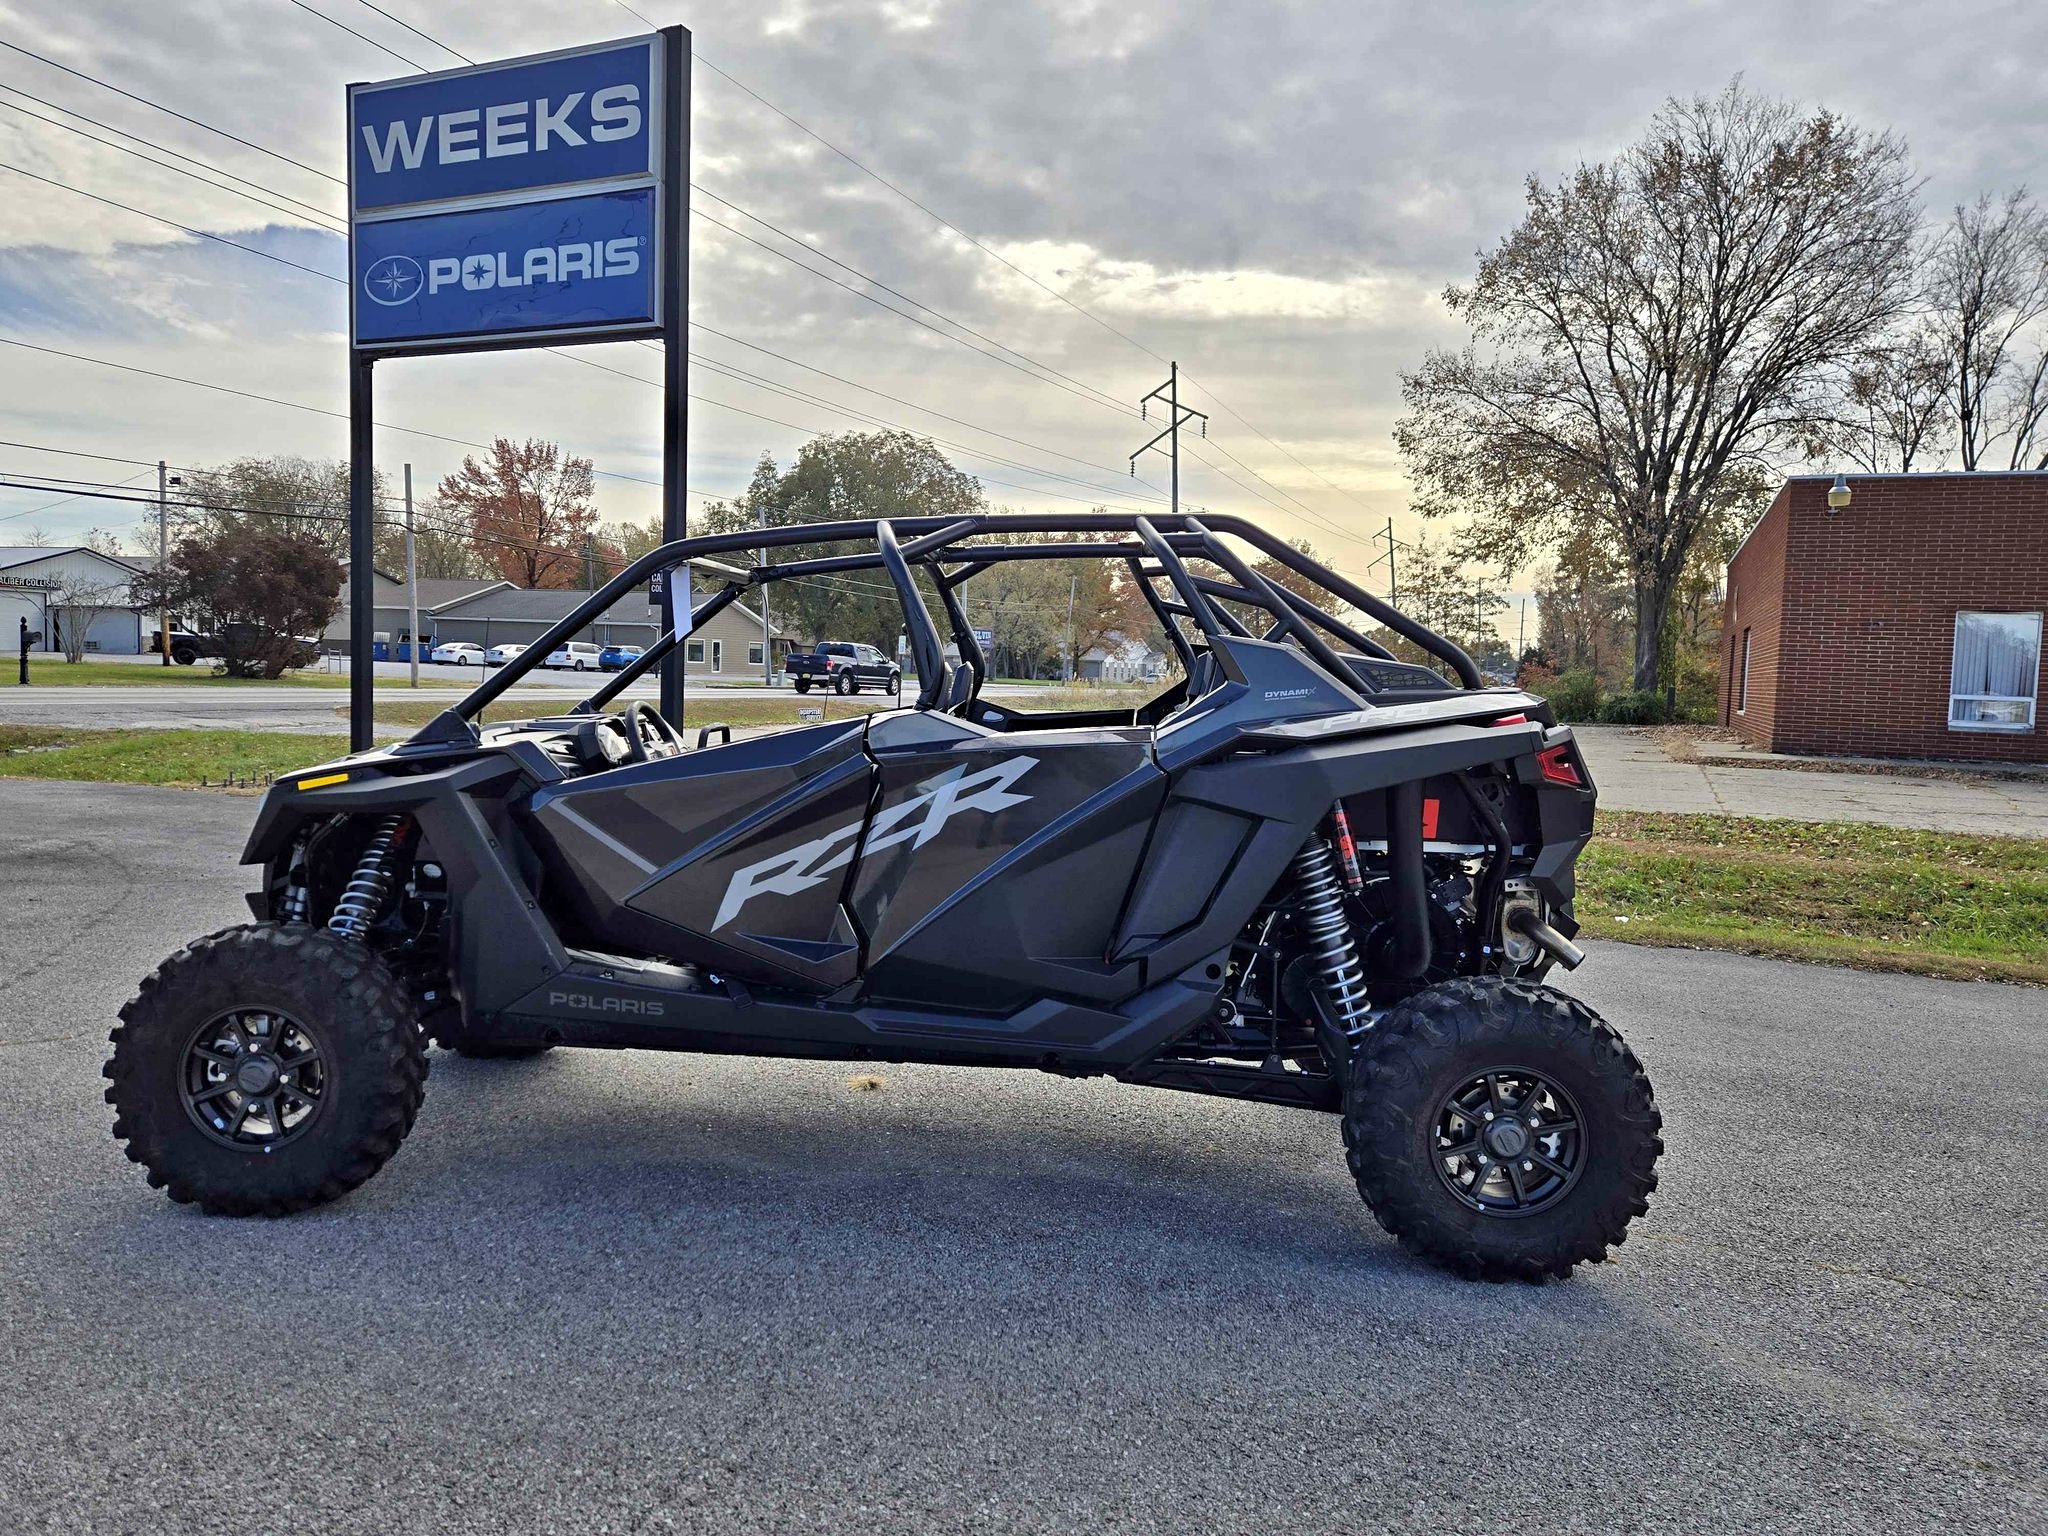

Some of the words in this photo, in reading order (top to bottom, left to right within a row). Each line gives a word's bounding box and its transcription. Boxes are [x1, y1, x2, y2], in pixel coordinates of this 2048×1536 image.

[361, 83, 642, 174] WEEKS
[428, 236, 640, 294] POLARIS
[1264, 686, 1317, 698] DYNAMIX
[710, 755, 1041, 933] RZR
[549, 991, 665, 1016] POLARIS
